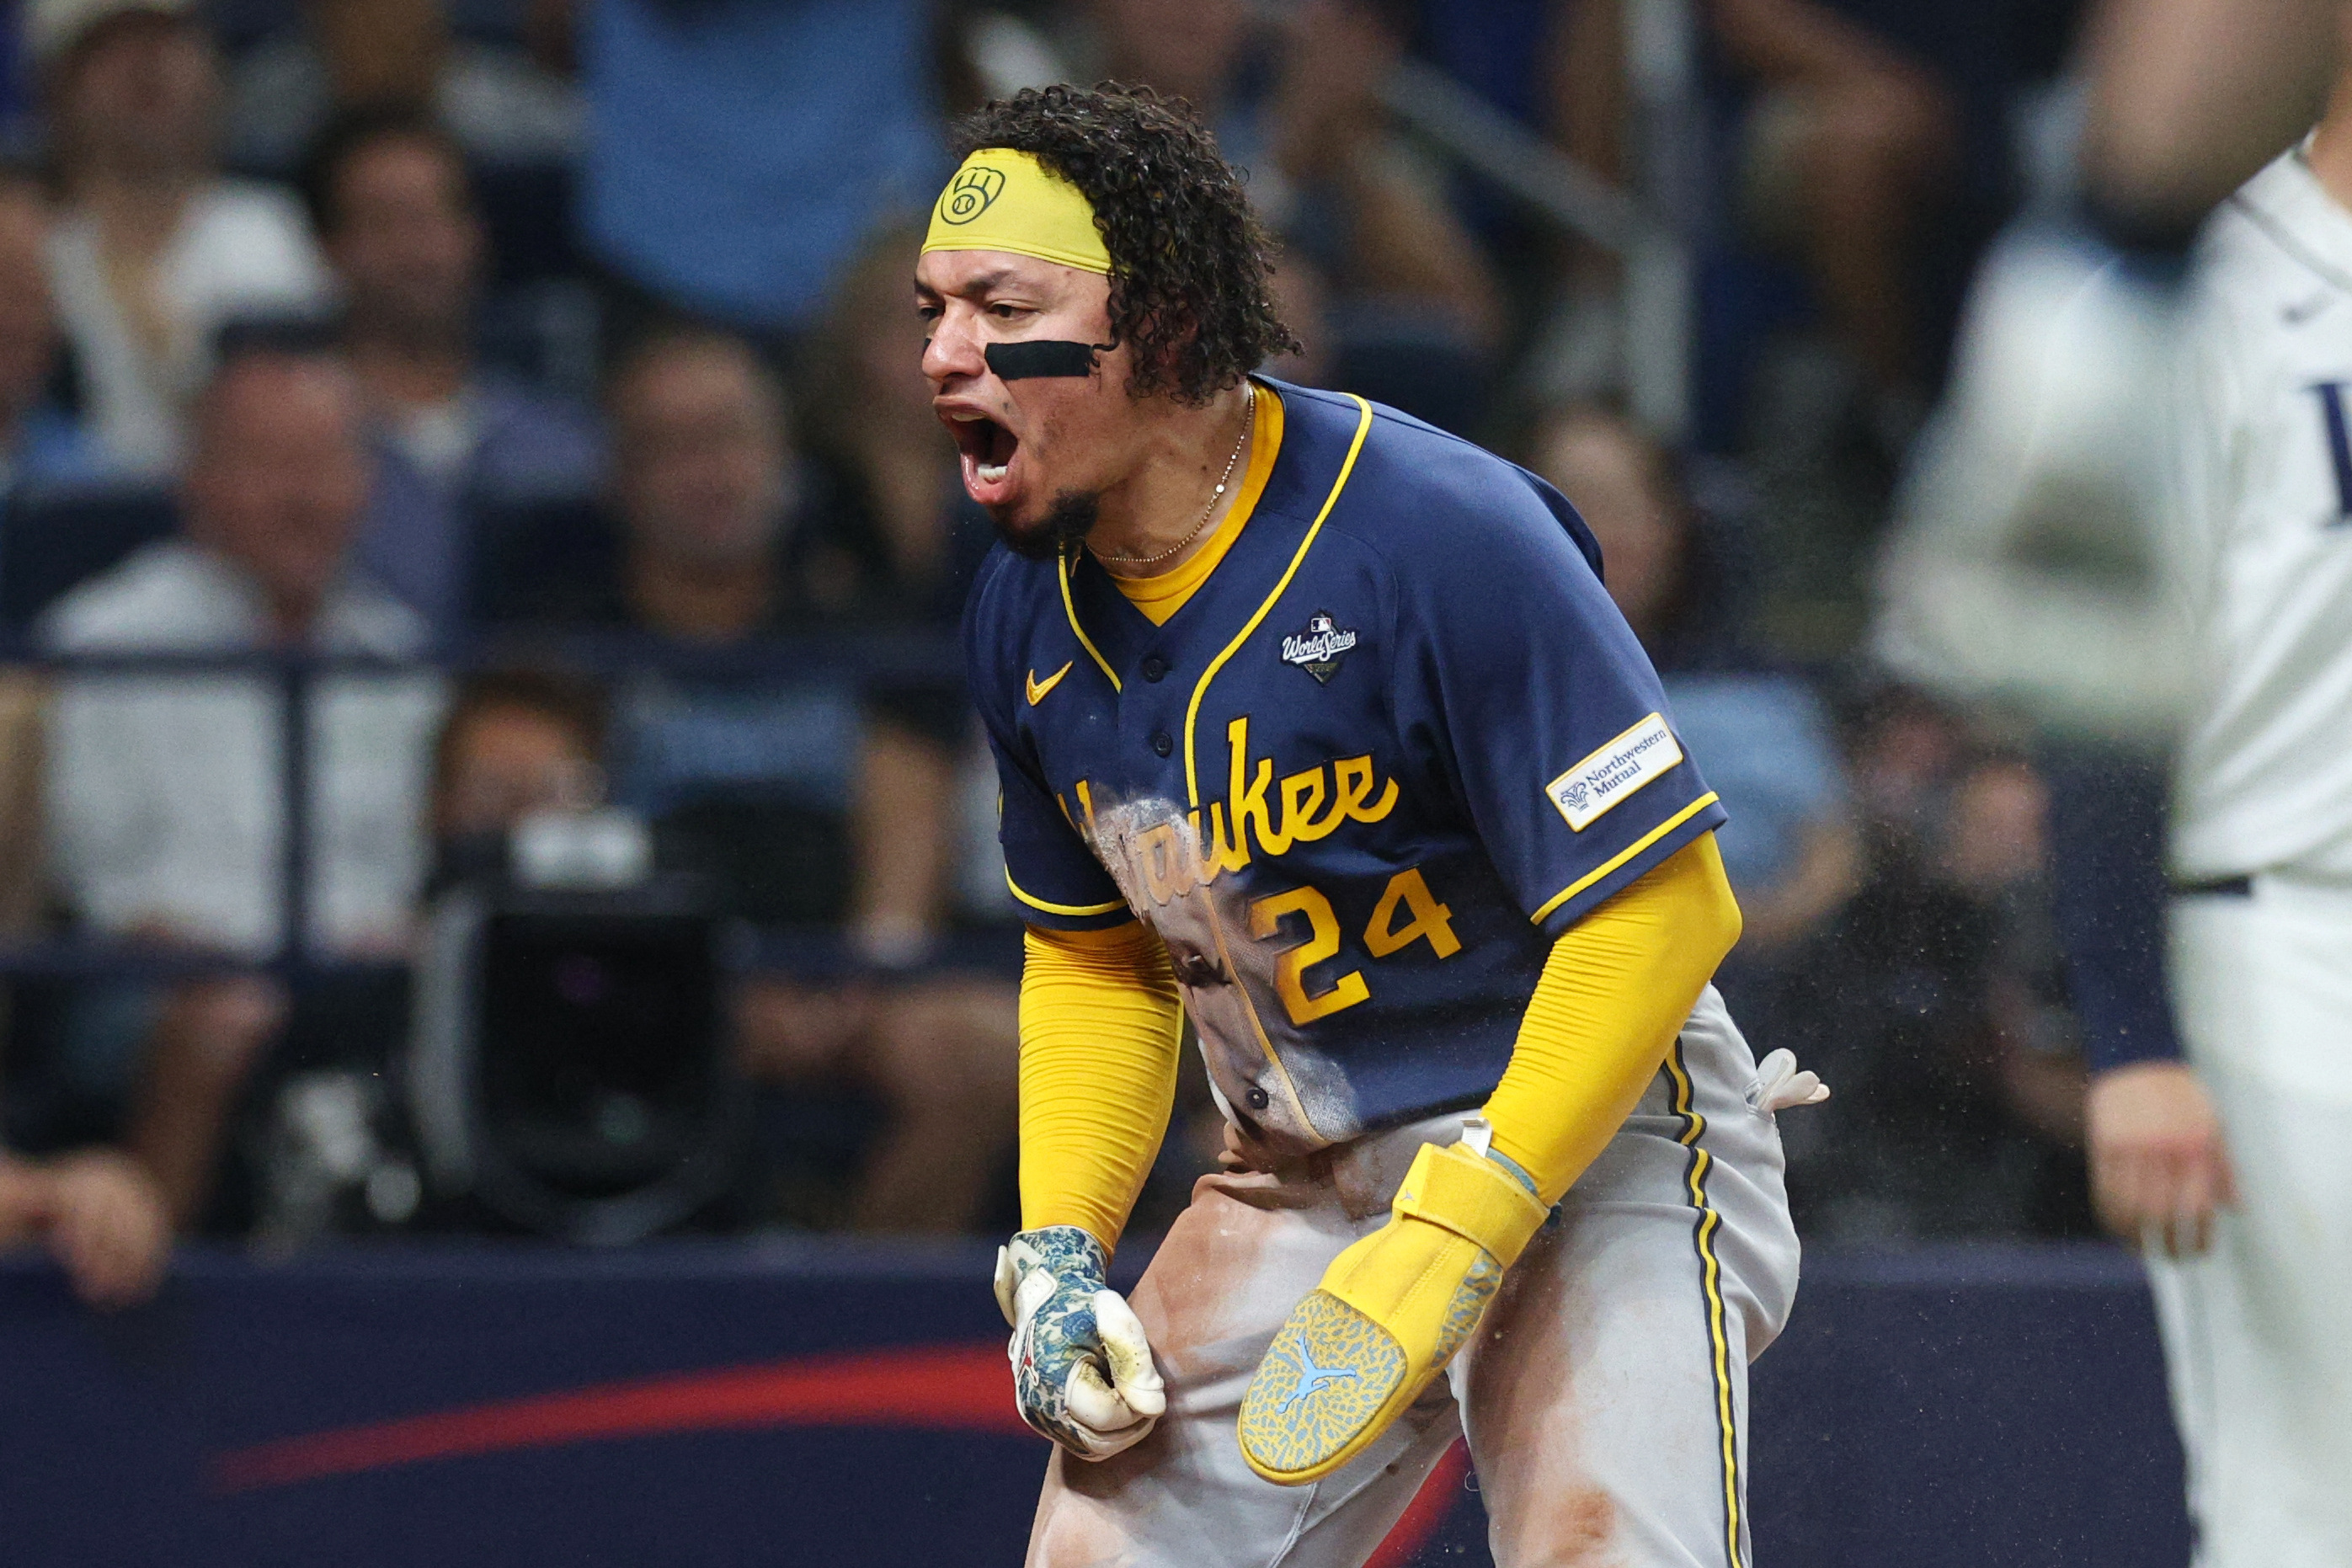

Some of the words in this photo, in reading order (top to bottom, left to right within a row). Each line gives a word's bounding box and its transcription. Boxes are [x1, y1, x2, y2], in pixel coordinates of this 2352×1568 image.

[1282, 634, 1326, 660] World
[1319, 630, 1357, 662] Series
[1586, 729, 1667, 787] Northwestern
[1593, 760, 1642, 798] Mutual
[1247, 865, 1463, 1027] 24
